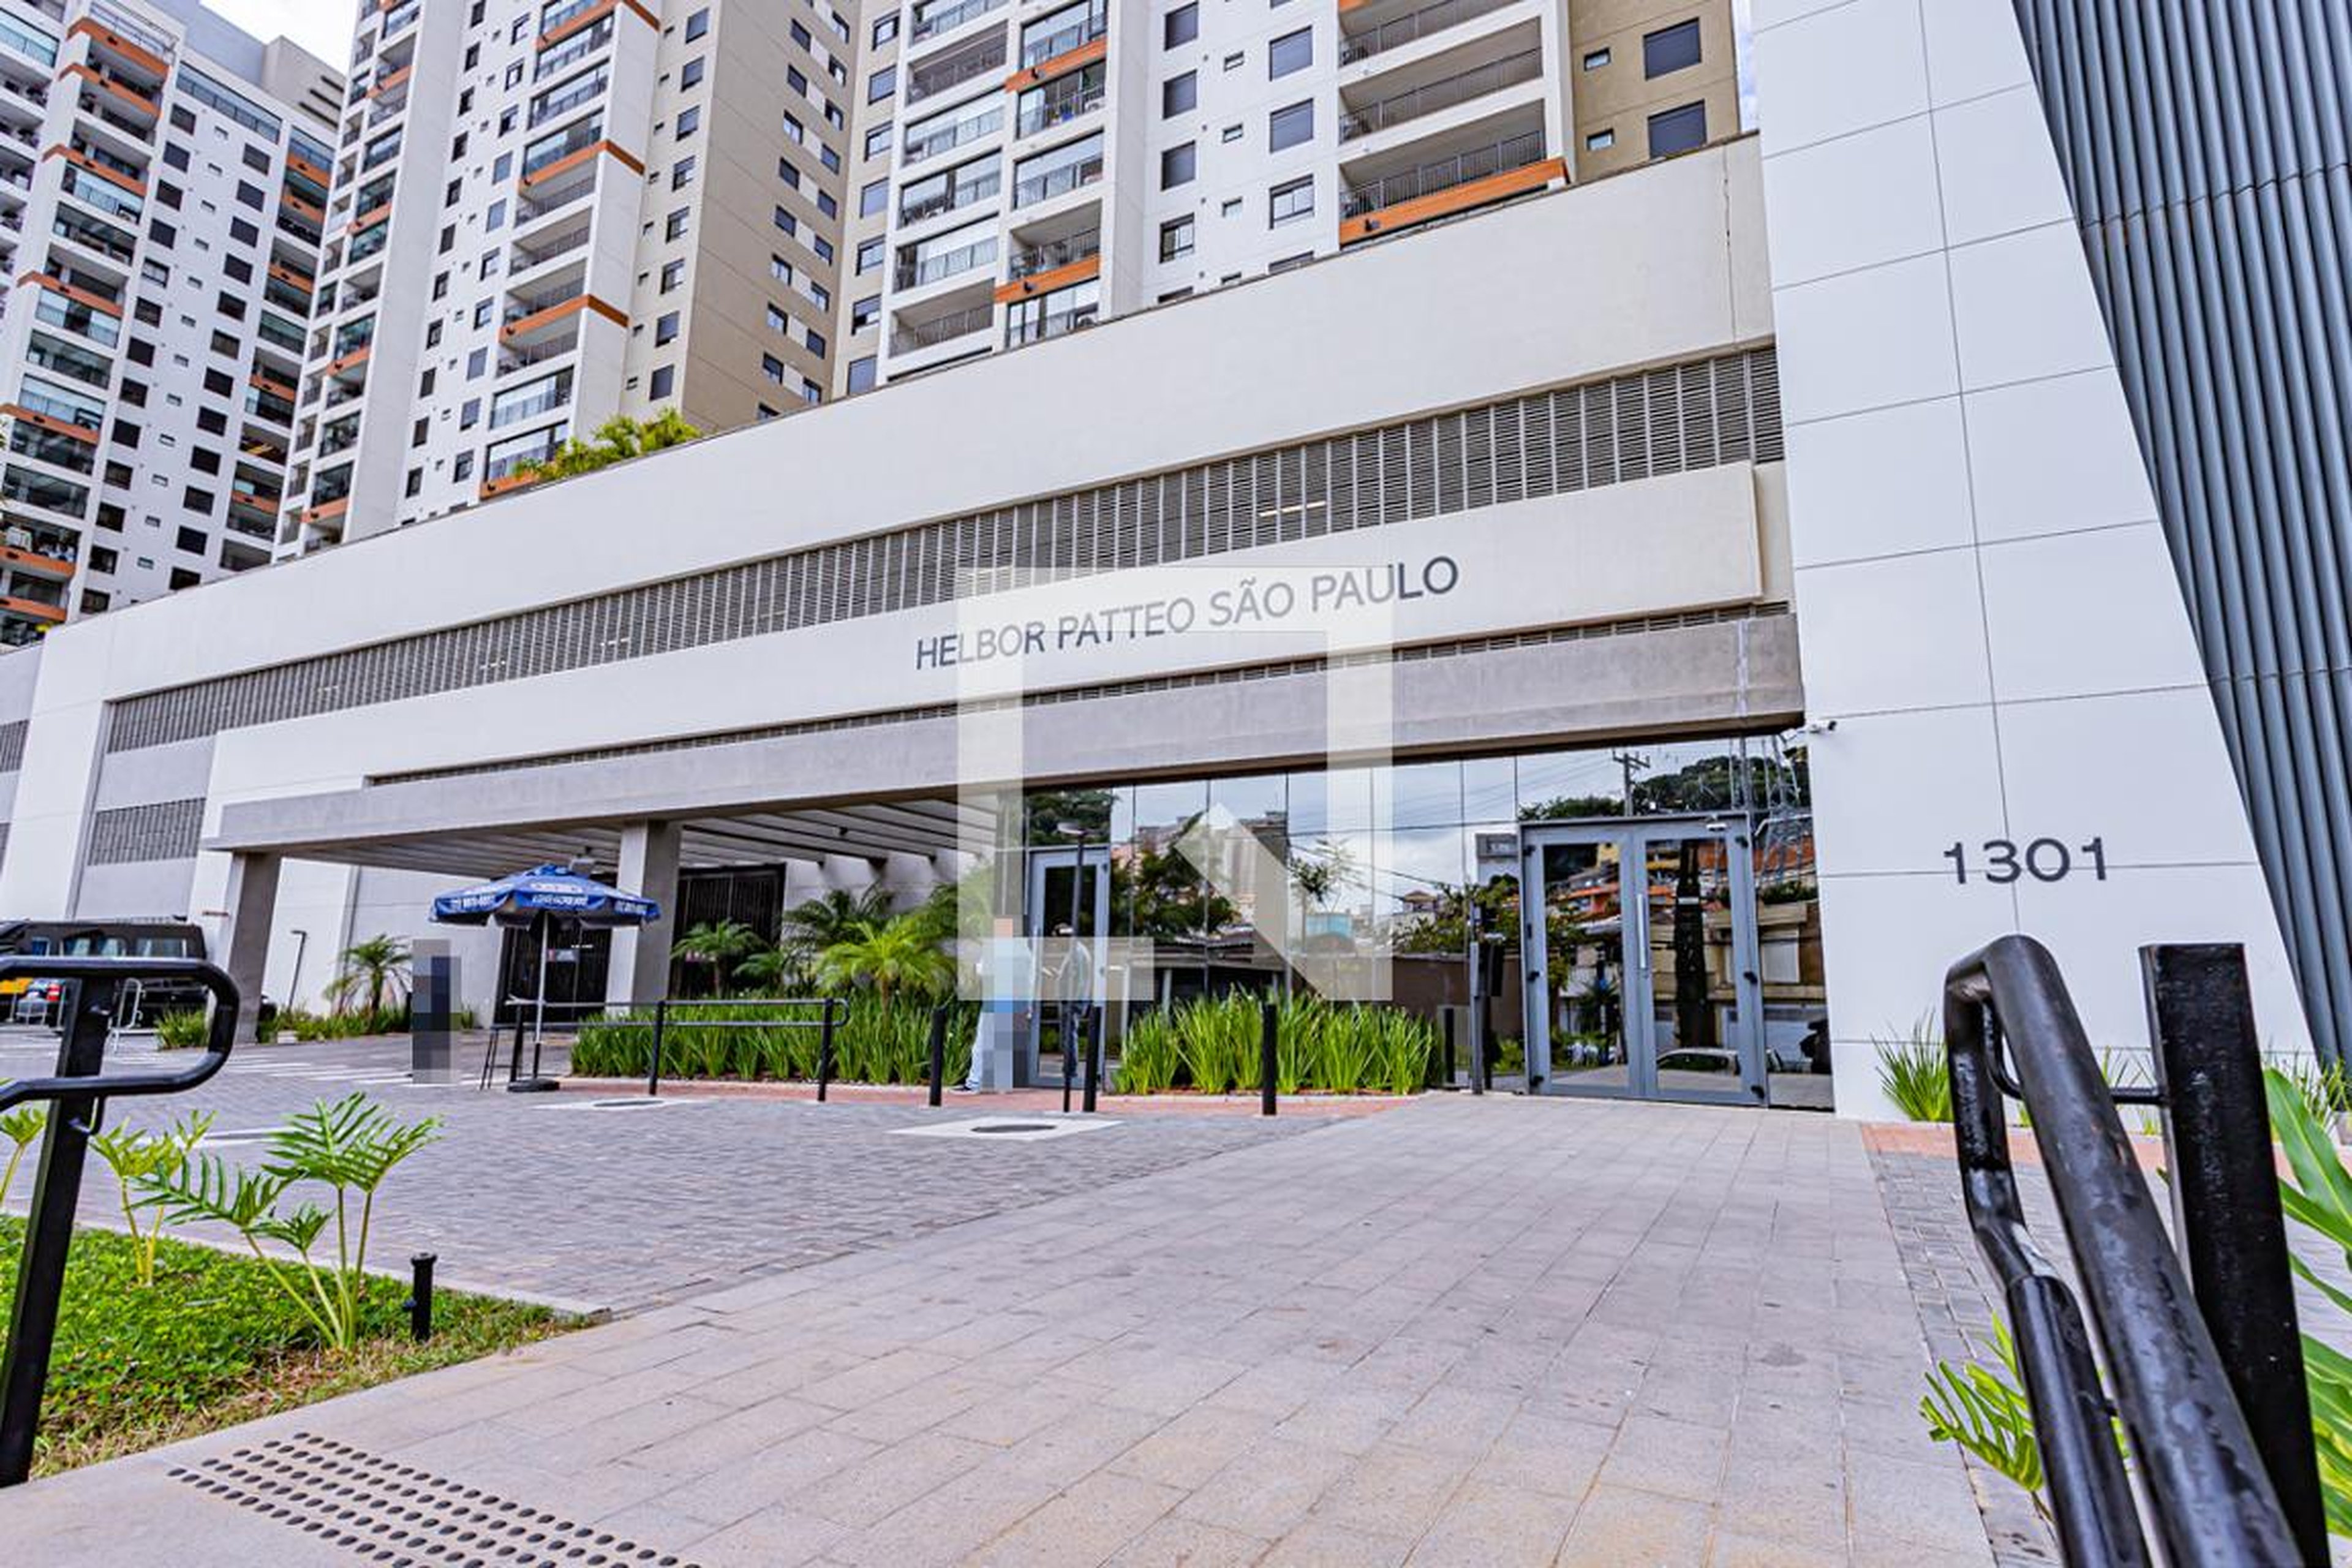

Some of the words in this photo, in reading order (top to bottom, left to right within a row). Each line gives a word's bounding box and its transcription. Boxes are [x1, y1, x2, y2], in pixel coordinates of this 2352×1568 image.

[917, 621, 1045, 670] HELBOR
[1058, 597, 1196, 649] PATTEO
[1208, 577, 1294, 626] SÃO
[1311, 556, 1458, 612] PAULO
[1943, 837, 2106, 884] 1301
